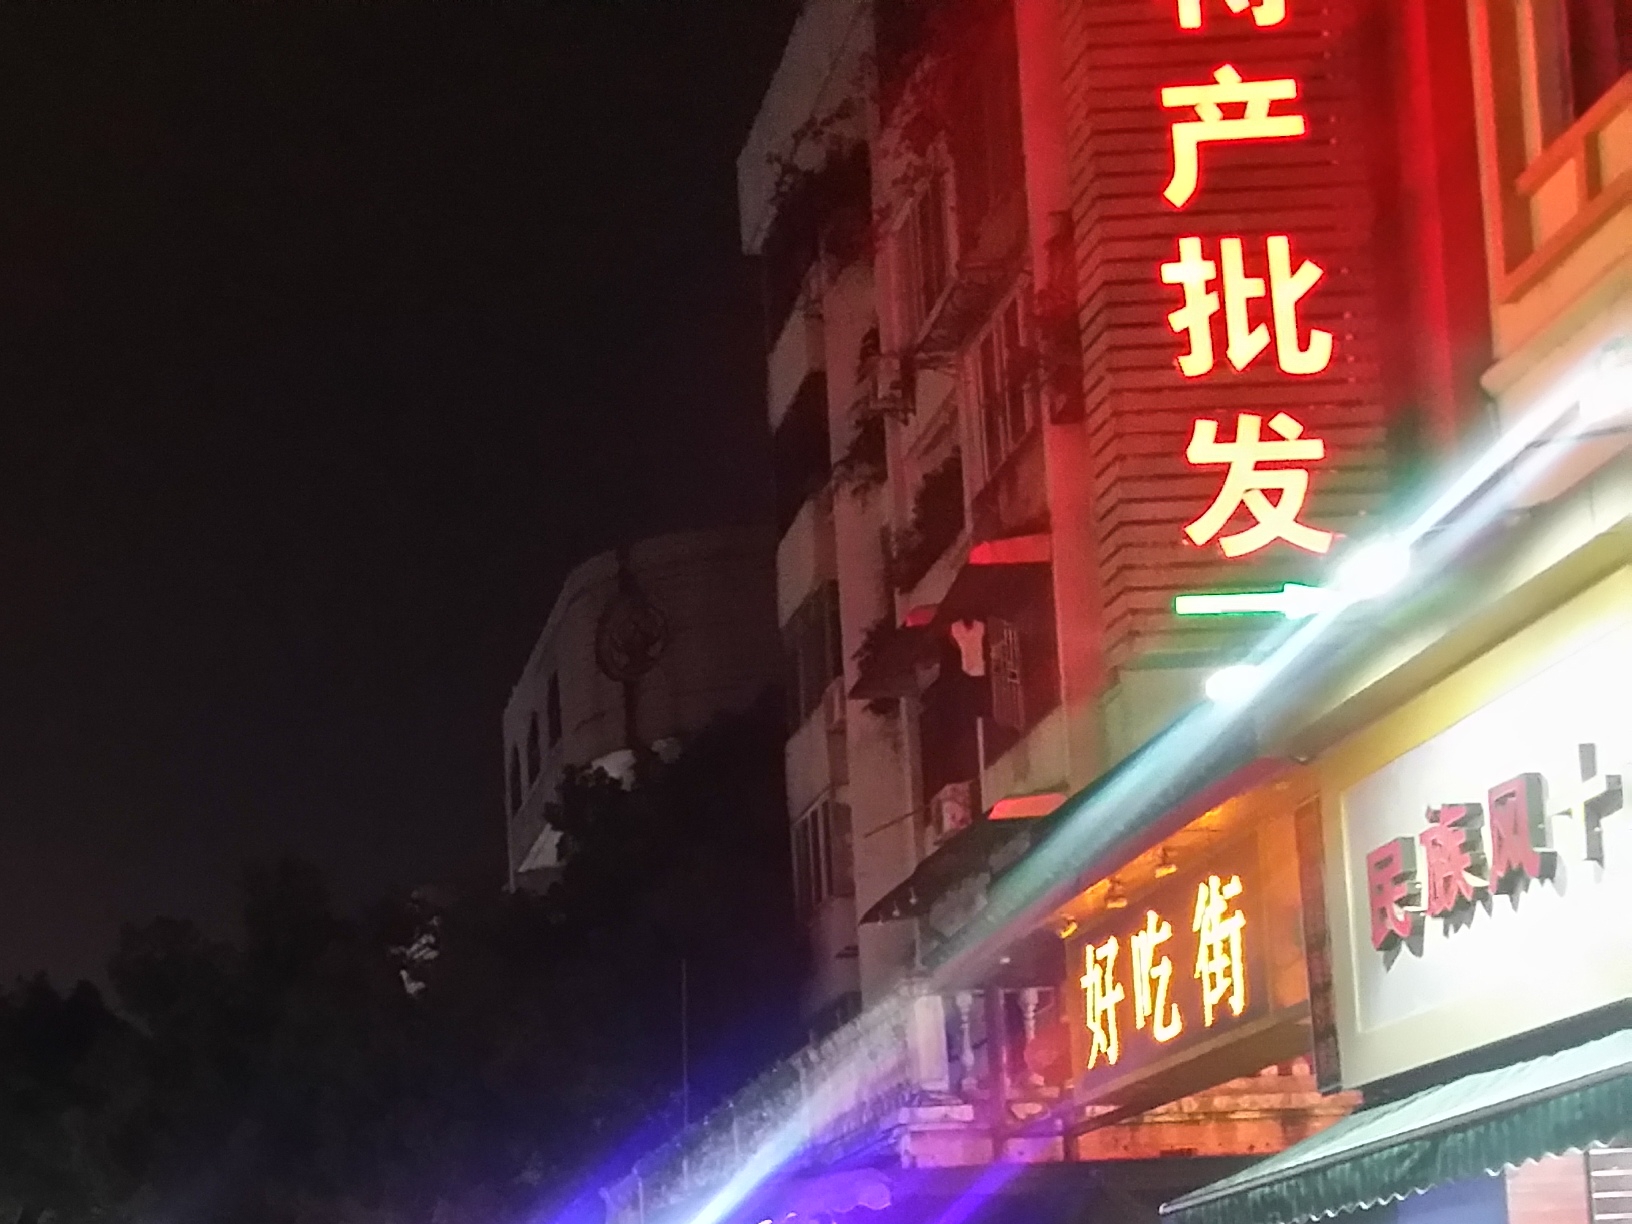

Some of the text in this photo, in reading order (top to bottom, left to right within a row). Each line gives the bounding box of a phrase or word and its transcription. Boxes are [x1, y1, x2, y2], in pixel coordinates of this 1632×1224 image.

[1365, 742, 1624, 952] 民族风
[1079, 873, 1247, 1070] 好吃街
